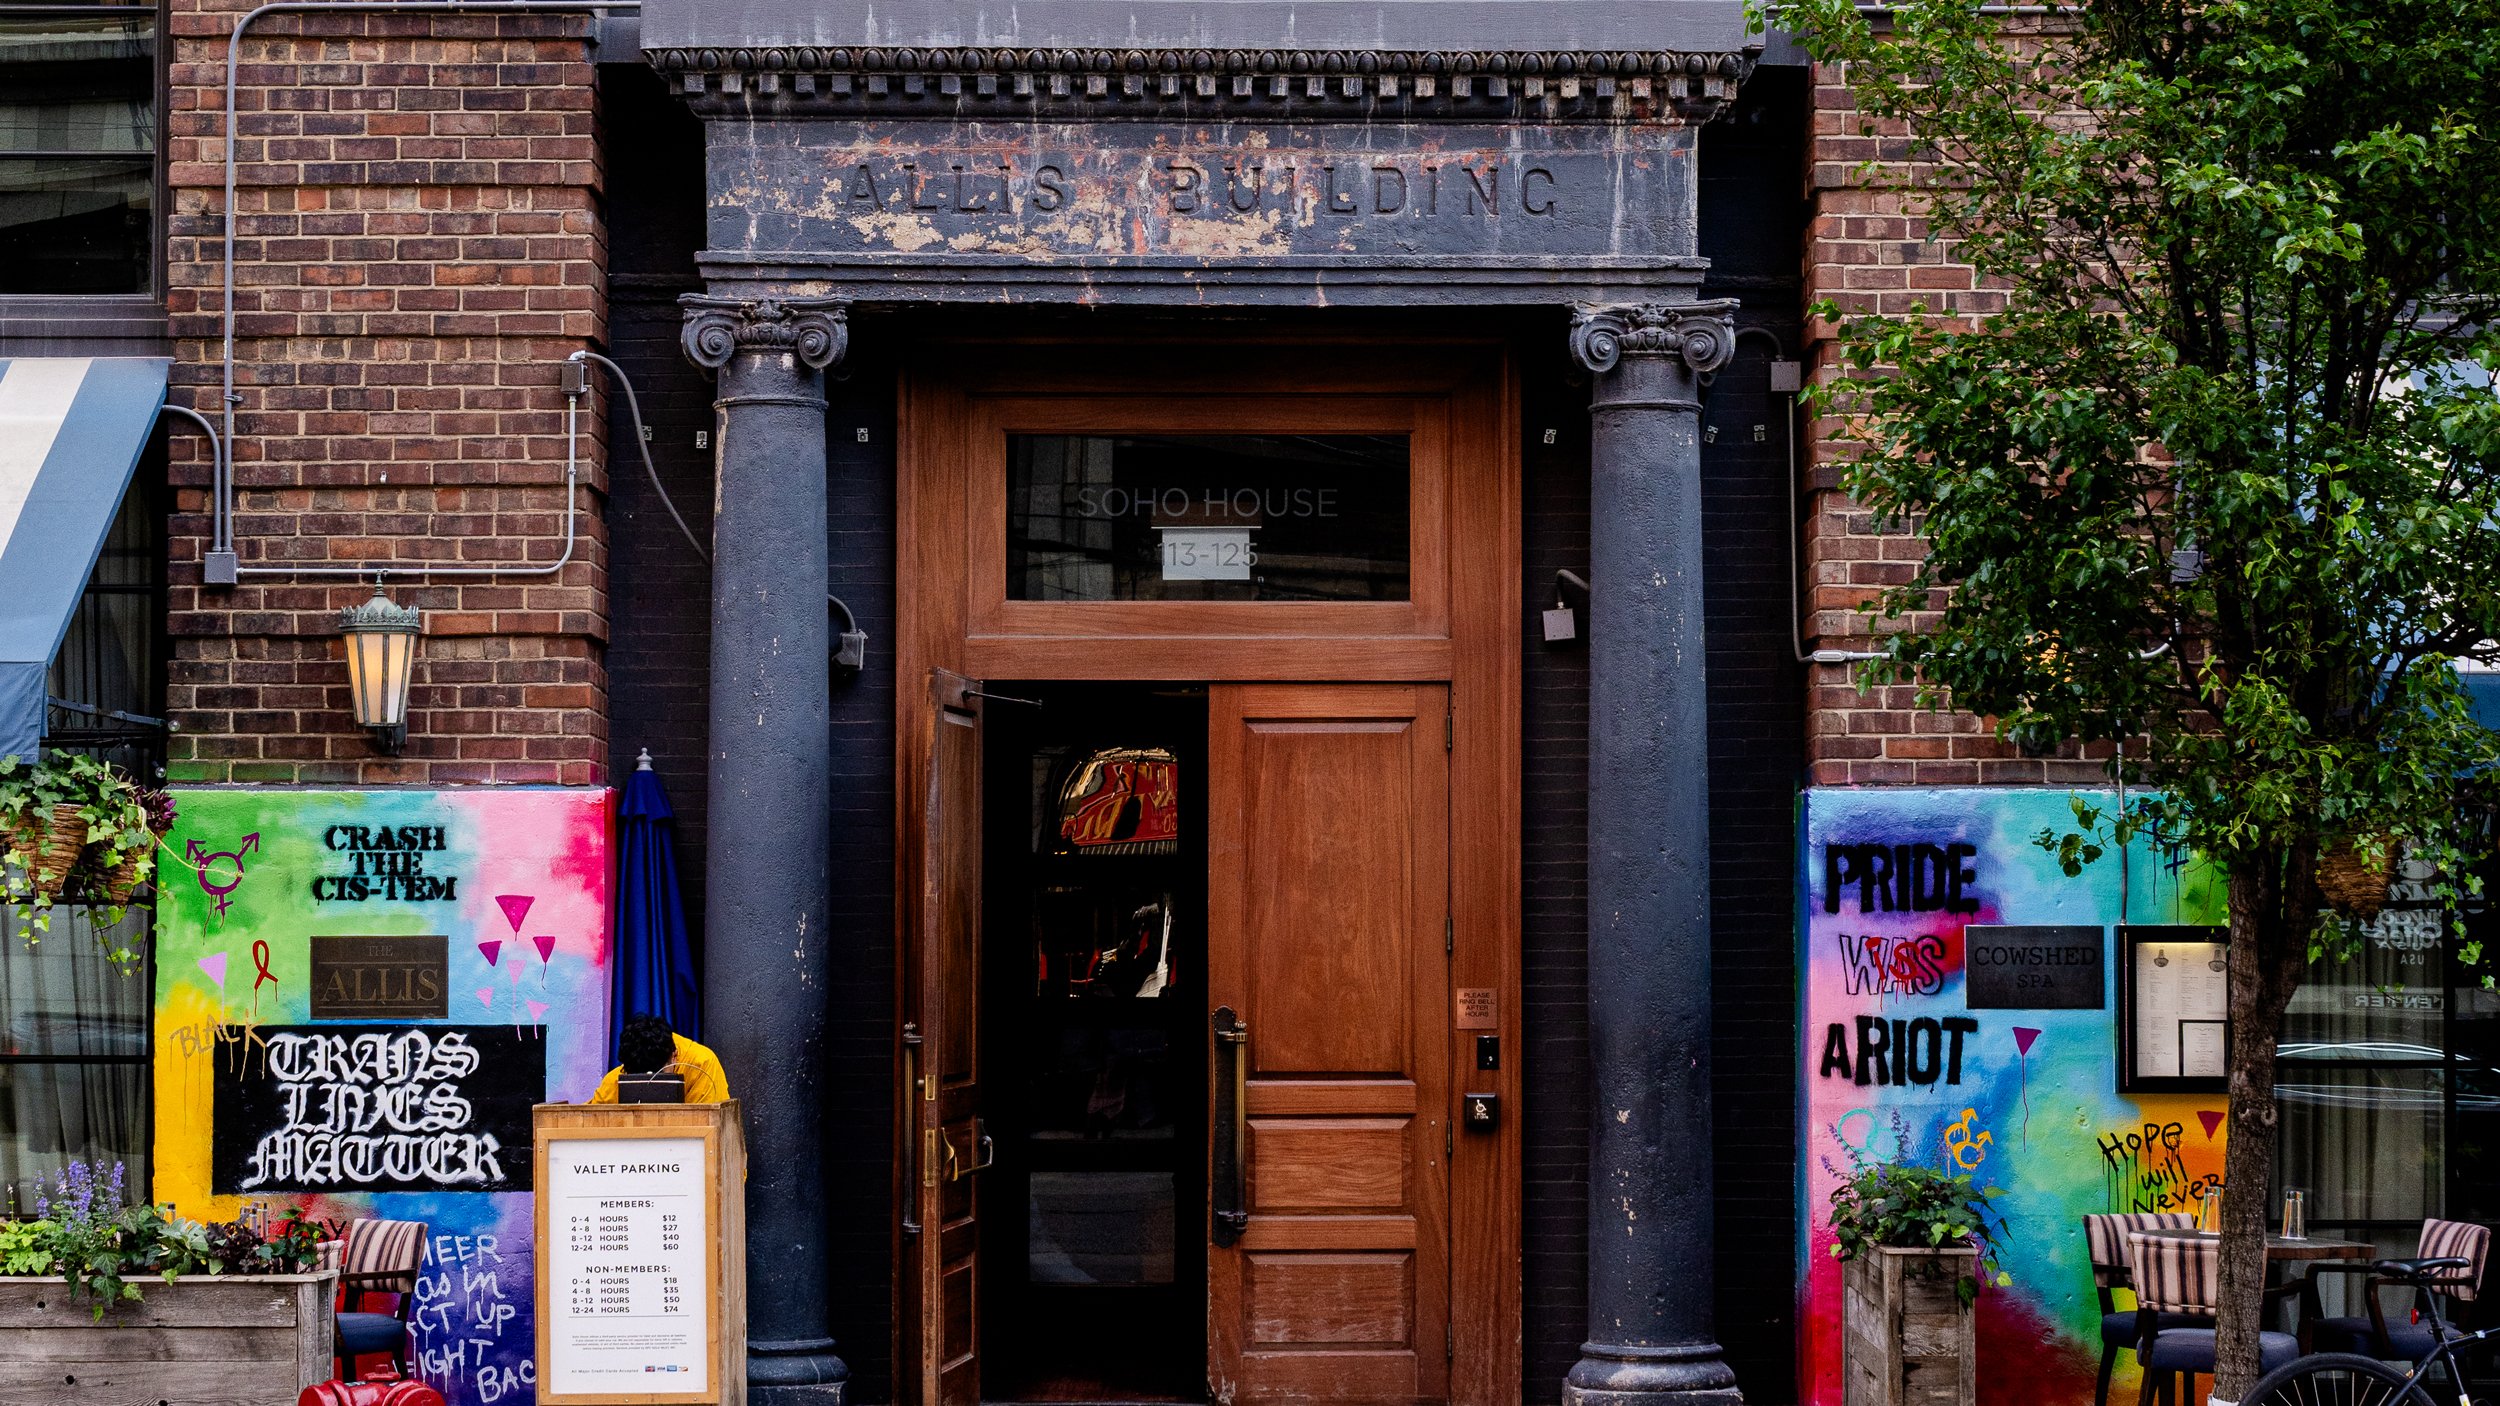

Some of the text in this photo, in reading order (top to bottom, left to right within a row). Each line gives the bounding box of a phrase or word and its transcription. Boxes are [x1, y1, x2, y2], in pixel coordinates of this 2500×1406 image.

[846, 164, 1556, 218] ALLIS BUILDING
[1077, 487, 1338, 518] SOHO HOUSE
[1157, 542, 1259, 567] 113-125
[324, 825, 447, 851] CRASH
[348, 851, 423, 876] THE
[1825, 843, 1980, 914] PRIDE
[312, 875, 458, 901] CIS-TEM
[367, 945, 394, 957] THE
[1839, 934, 1945, 996] WAS
[1975, 946, 2097, 966] COWSHED
[321, 968, 440, 1001] ALLIS
[2017, 974, 2055, 989] SPA
[170, 1008, 267, 1059] BLACK
[267, 1029, 480, 1085] TRANS
[278, 1082, 472, 1134] LIVES
[241, 1130, 506, 1189] MATTER
[574, 1163, 680, 1174] VALET PARKING
[2141, 1154, 2189, 1190] will
[600, 1200, 655, 1208] MEMBERS:
[462, 1264, 506, 1299] in
[586, 1265, 671, 1273] NON-MEMBERS:
[475, 1301, 516, 1336] UP
